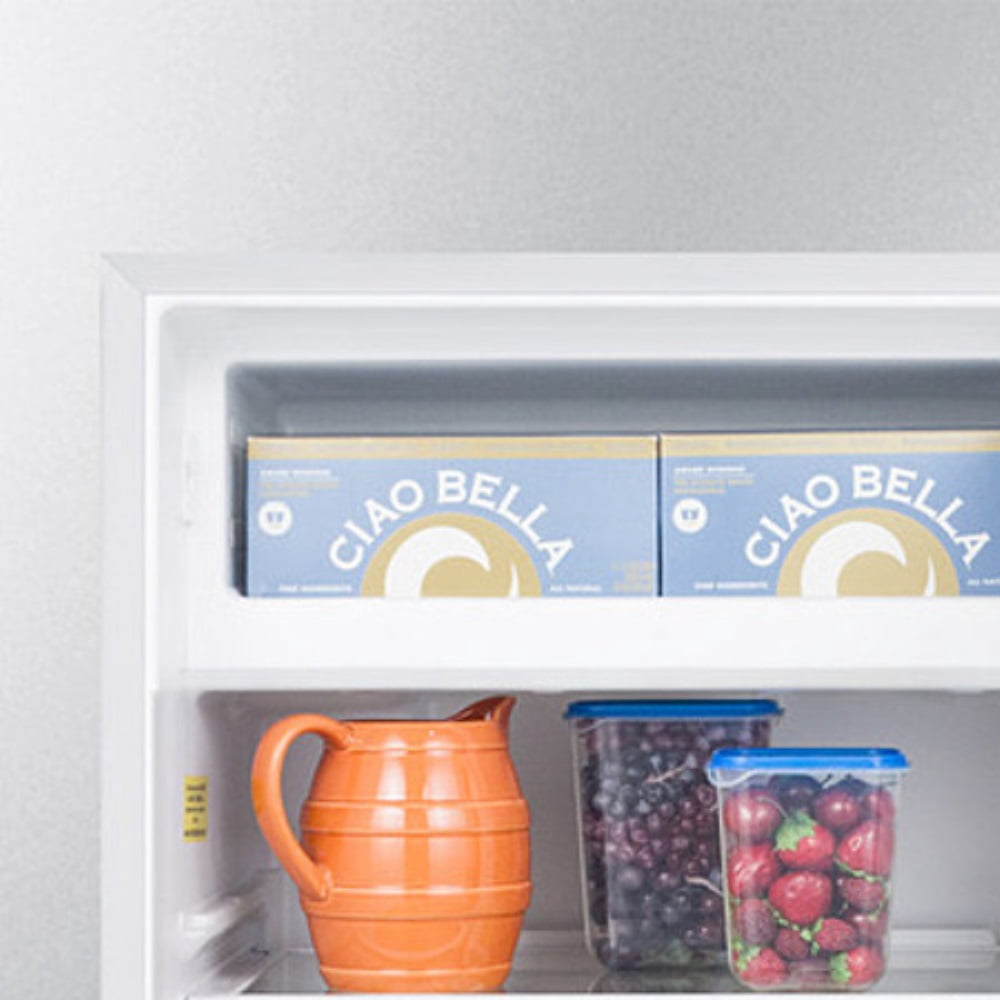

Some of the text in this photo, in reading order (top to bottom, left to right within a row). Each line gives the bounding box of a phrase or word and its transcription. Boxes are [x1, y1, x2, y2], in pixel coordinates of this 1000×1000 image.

[329, 469, 574, 577] CIAO BELLA
[745, 464, 992, 570] CIAO BELLA
